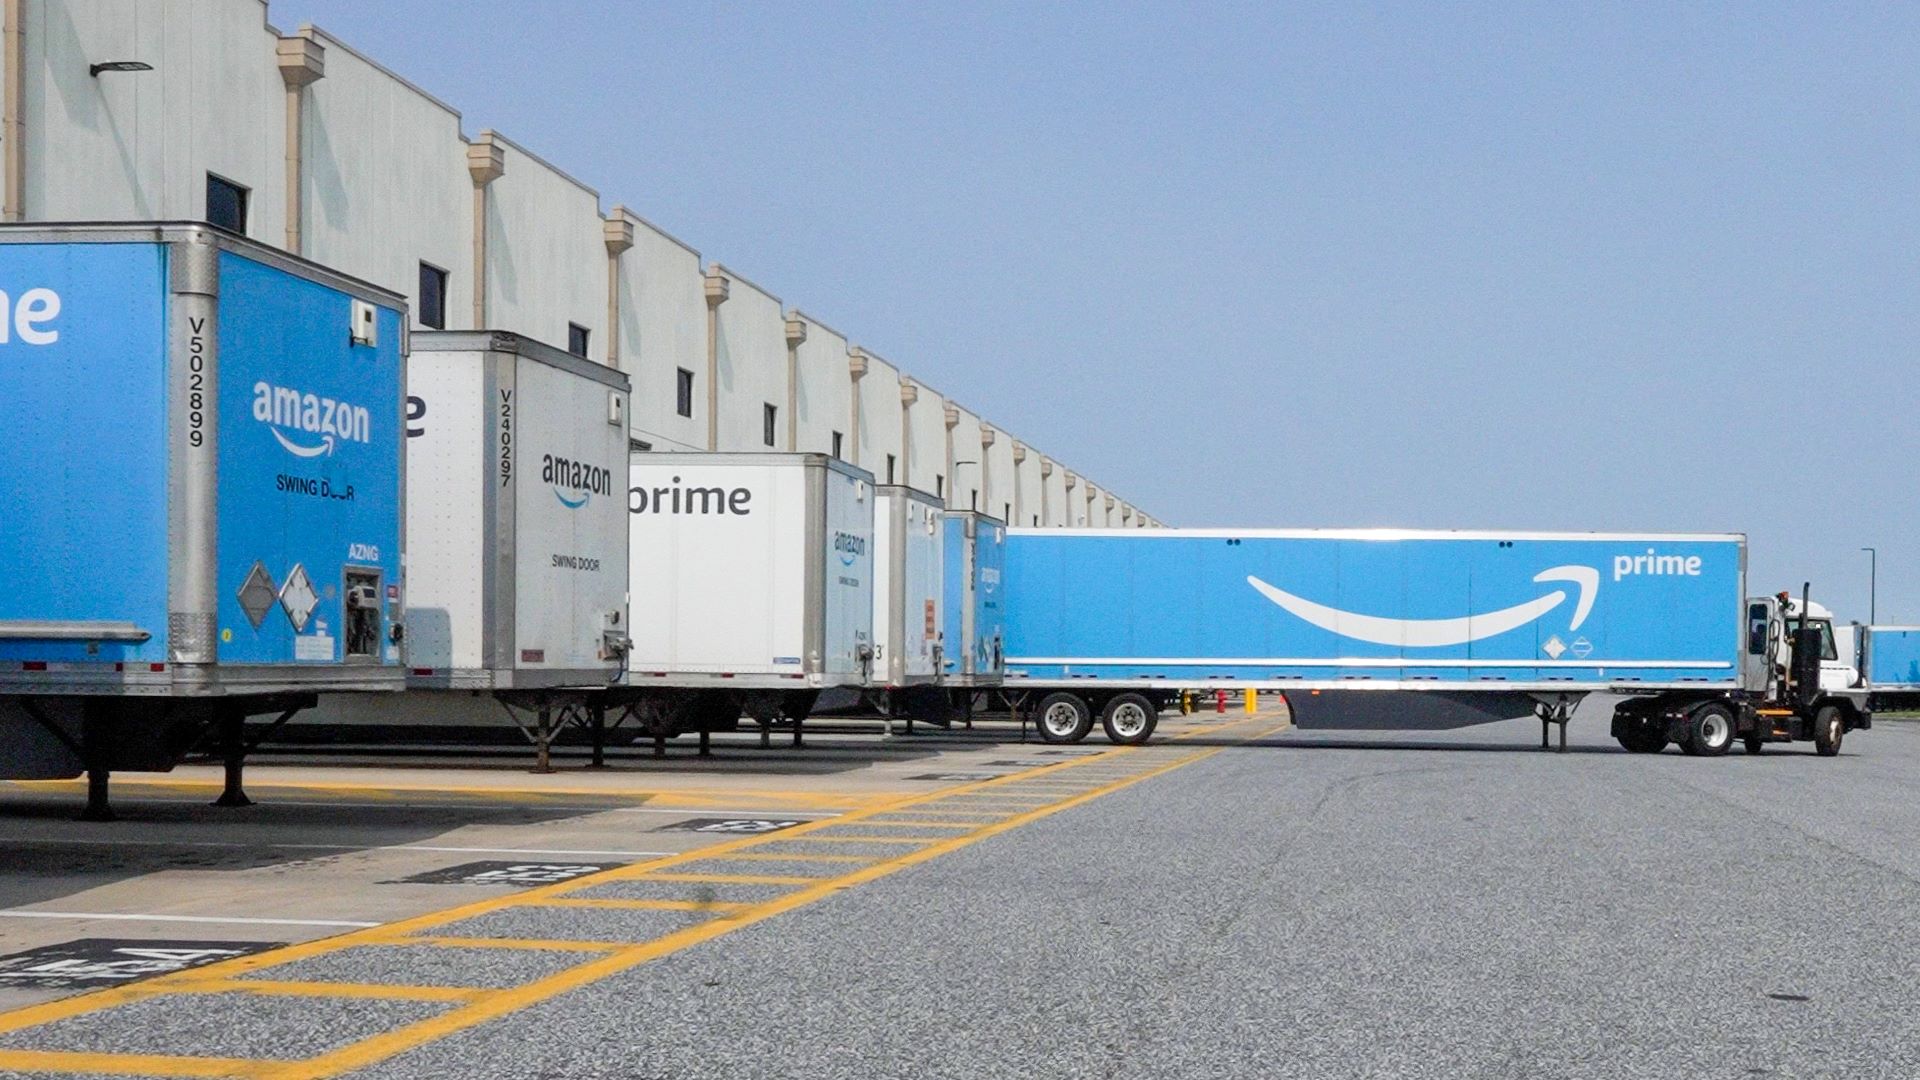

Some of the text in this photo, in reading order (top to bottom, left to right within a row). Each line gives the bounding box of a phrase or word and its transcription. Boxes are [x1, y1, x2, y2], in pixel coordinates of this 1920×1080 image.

[188, 316, 204, 448] V502899
[253, 381, 369, 443] amazon
[500, 389, 512, 487] V240297
[276, 473, 354, 501] SWING DR
[542, 453, 611, 497] amazon
[348, 543, 379, 561] AZNG
[834, 530, 865, 556] amazon
[551, 554, 600, 571] SWING DOOR
[1614, 548, 1702, 581] prime
